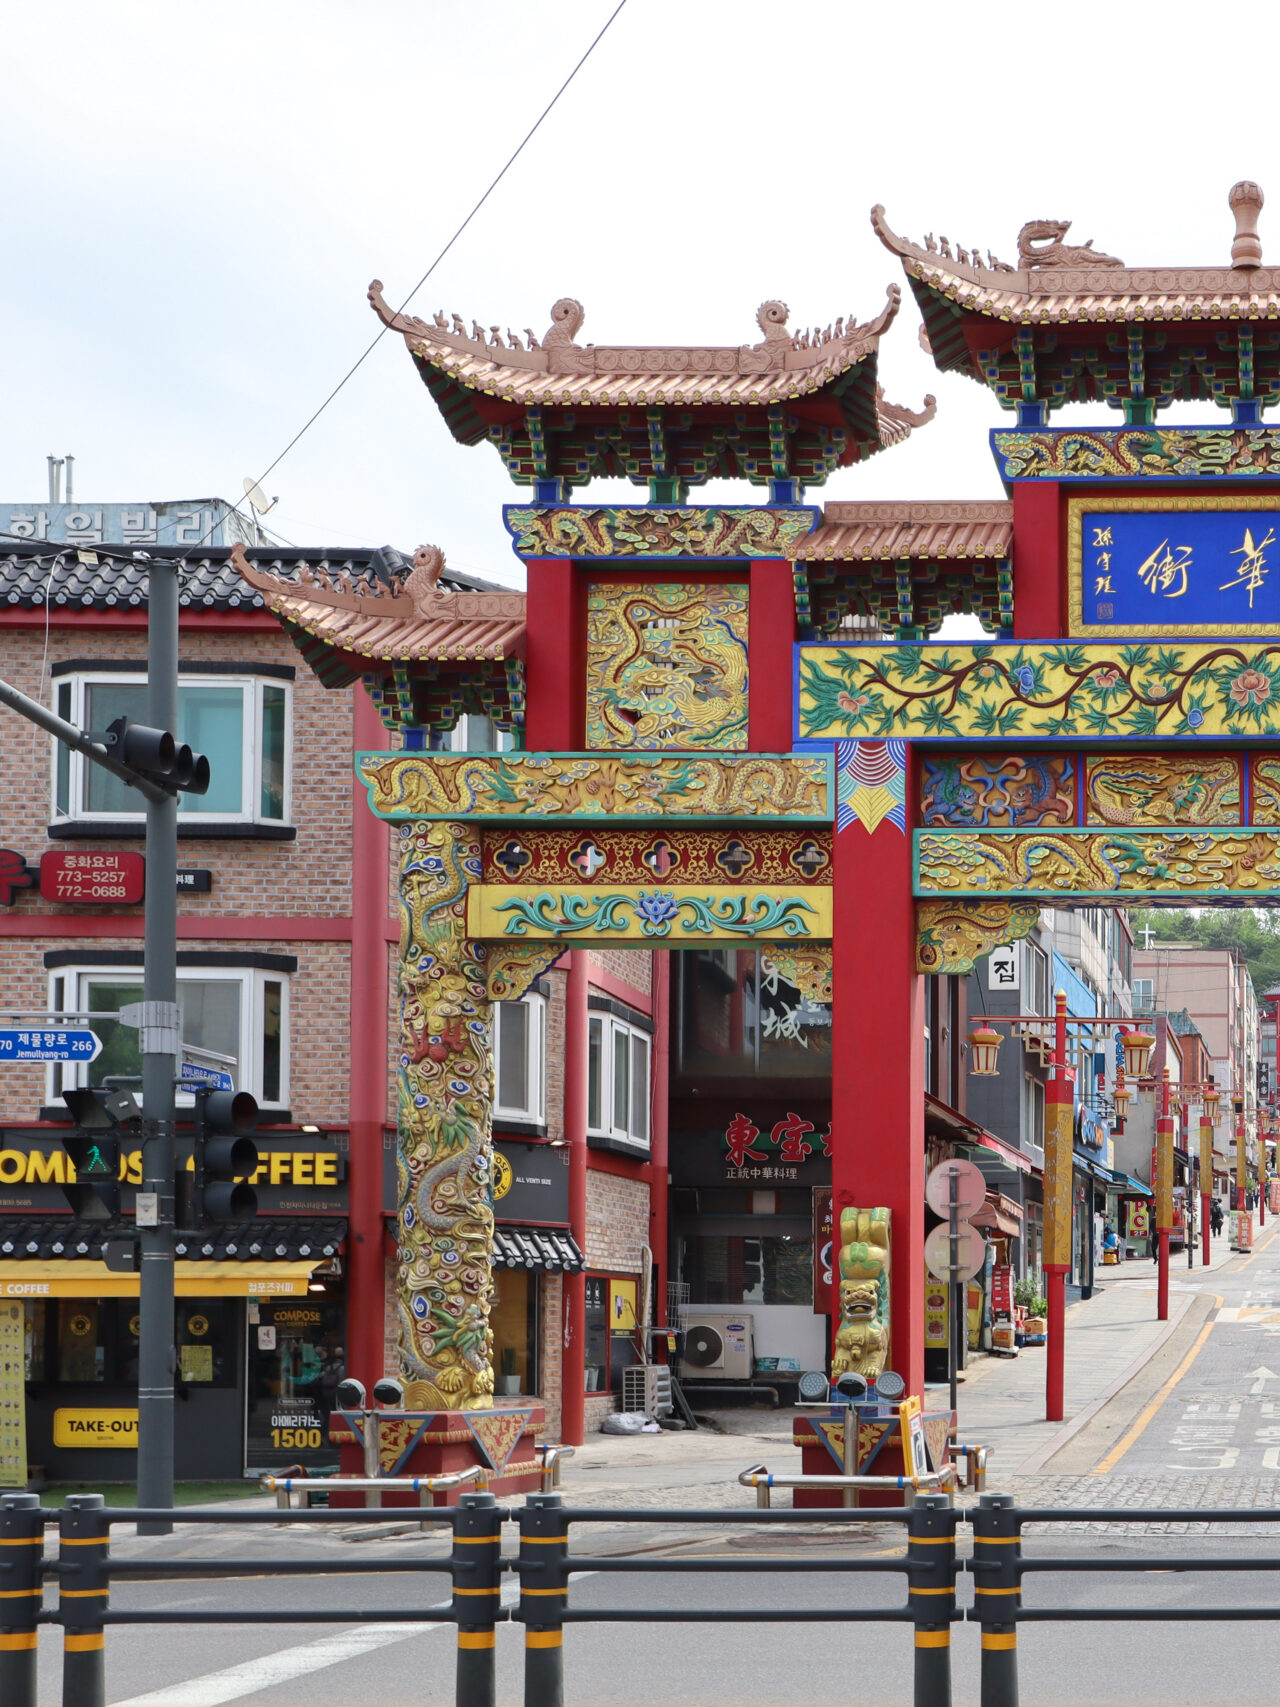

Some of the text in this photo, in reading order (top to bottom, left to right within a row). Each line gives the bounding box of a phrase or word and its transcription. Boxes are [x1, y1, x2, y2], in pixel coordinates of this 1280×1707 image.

[64, 856, 119, 868] 중화요리
[56, 871, 125, 882] 773-5257
[56, 886, 126, 897] 772-0688
[17, 1033, 68, 1048] 제물량로
[72, 1041, 92, 1051] 266
[16, 1049, 69, 1060] Jemullyang-ro
[726, 1166, 797, 1180] 正統中華料理
[516, 1176, 525, 1184] ALL
[7, 1284, 50, 1294] COFFEE
[248, 1282, 294, 1293] 컴포즈커피
[273, 1311, 321, 1322] COMPOSE
[68, 1420, 139, 1433] TAKE-OUT
[271, 1415, 321, 1427] 아메리카노
[270, 1428, 322, 1448] 1500
